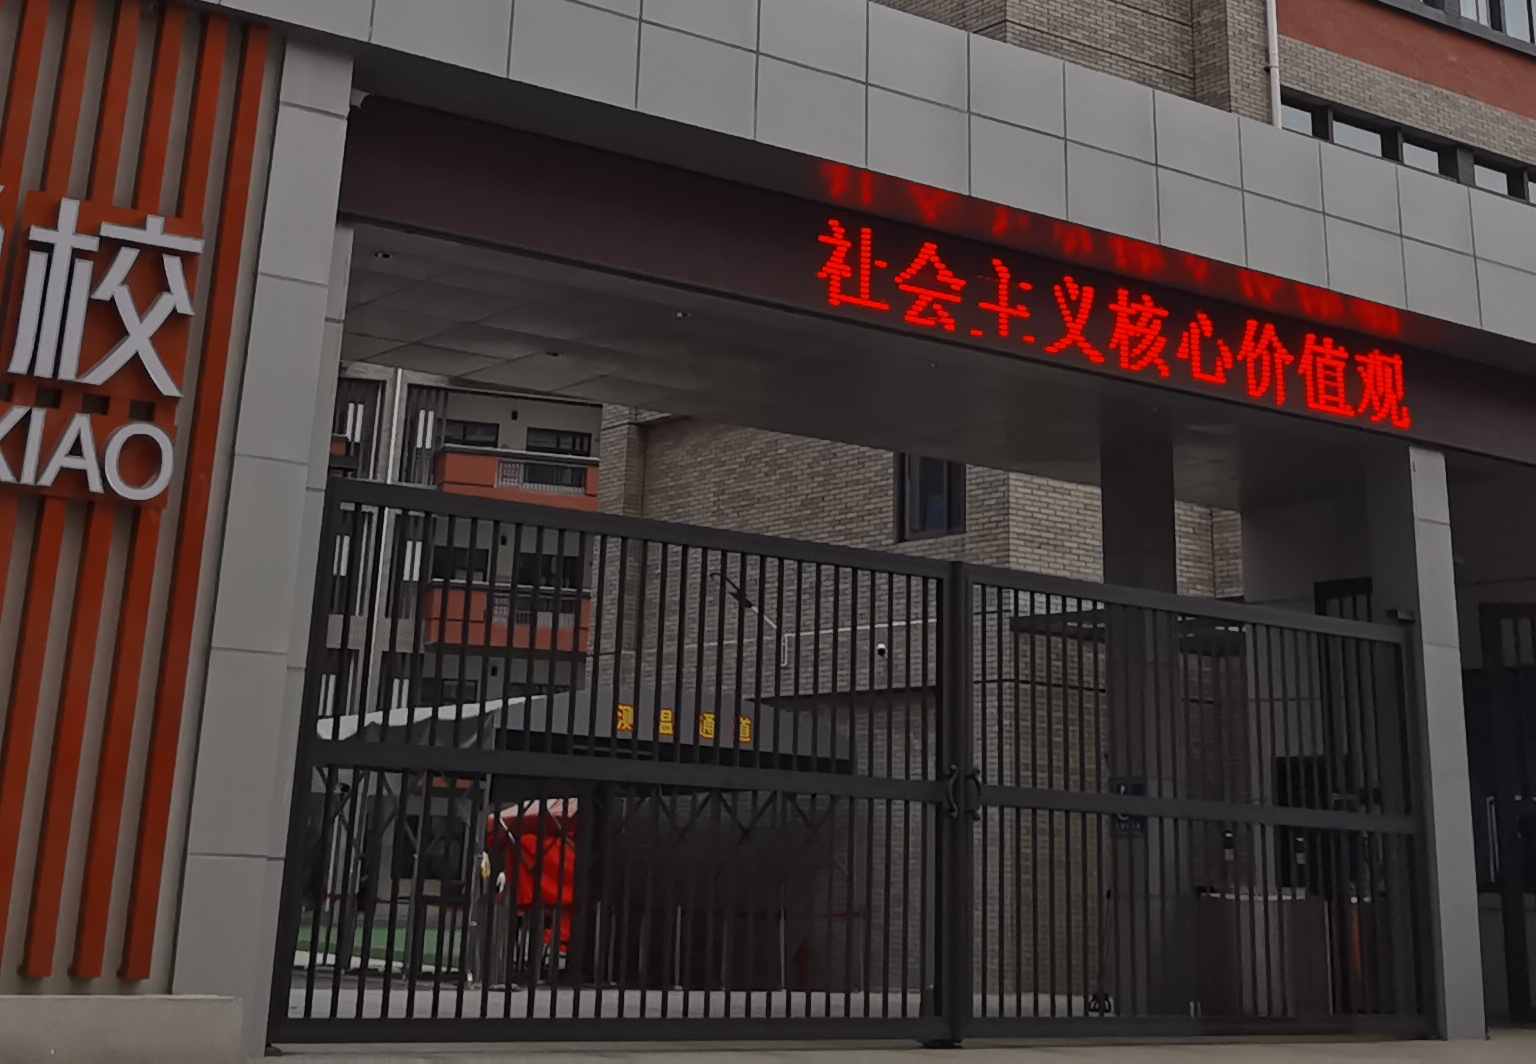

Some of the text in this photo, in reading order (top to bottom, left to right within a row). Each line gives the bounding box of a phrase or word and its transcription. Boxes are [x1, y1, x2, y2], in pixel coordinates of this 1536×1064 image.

[817, 219, 1412, 430] 社会主义核心价值观
